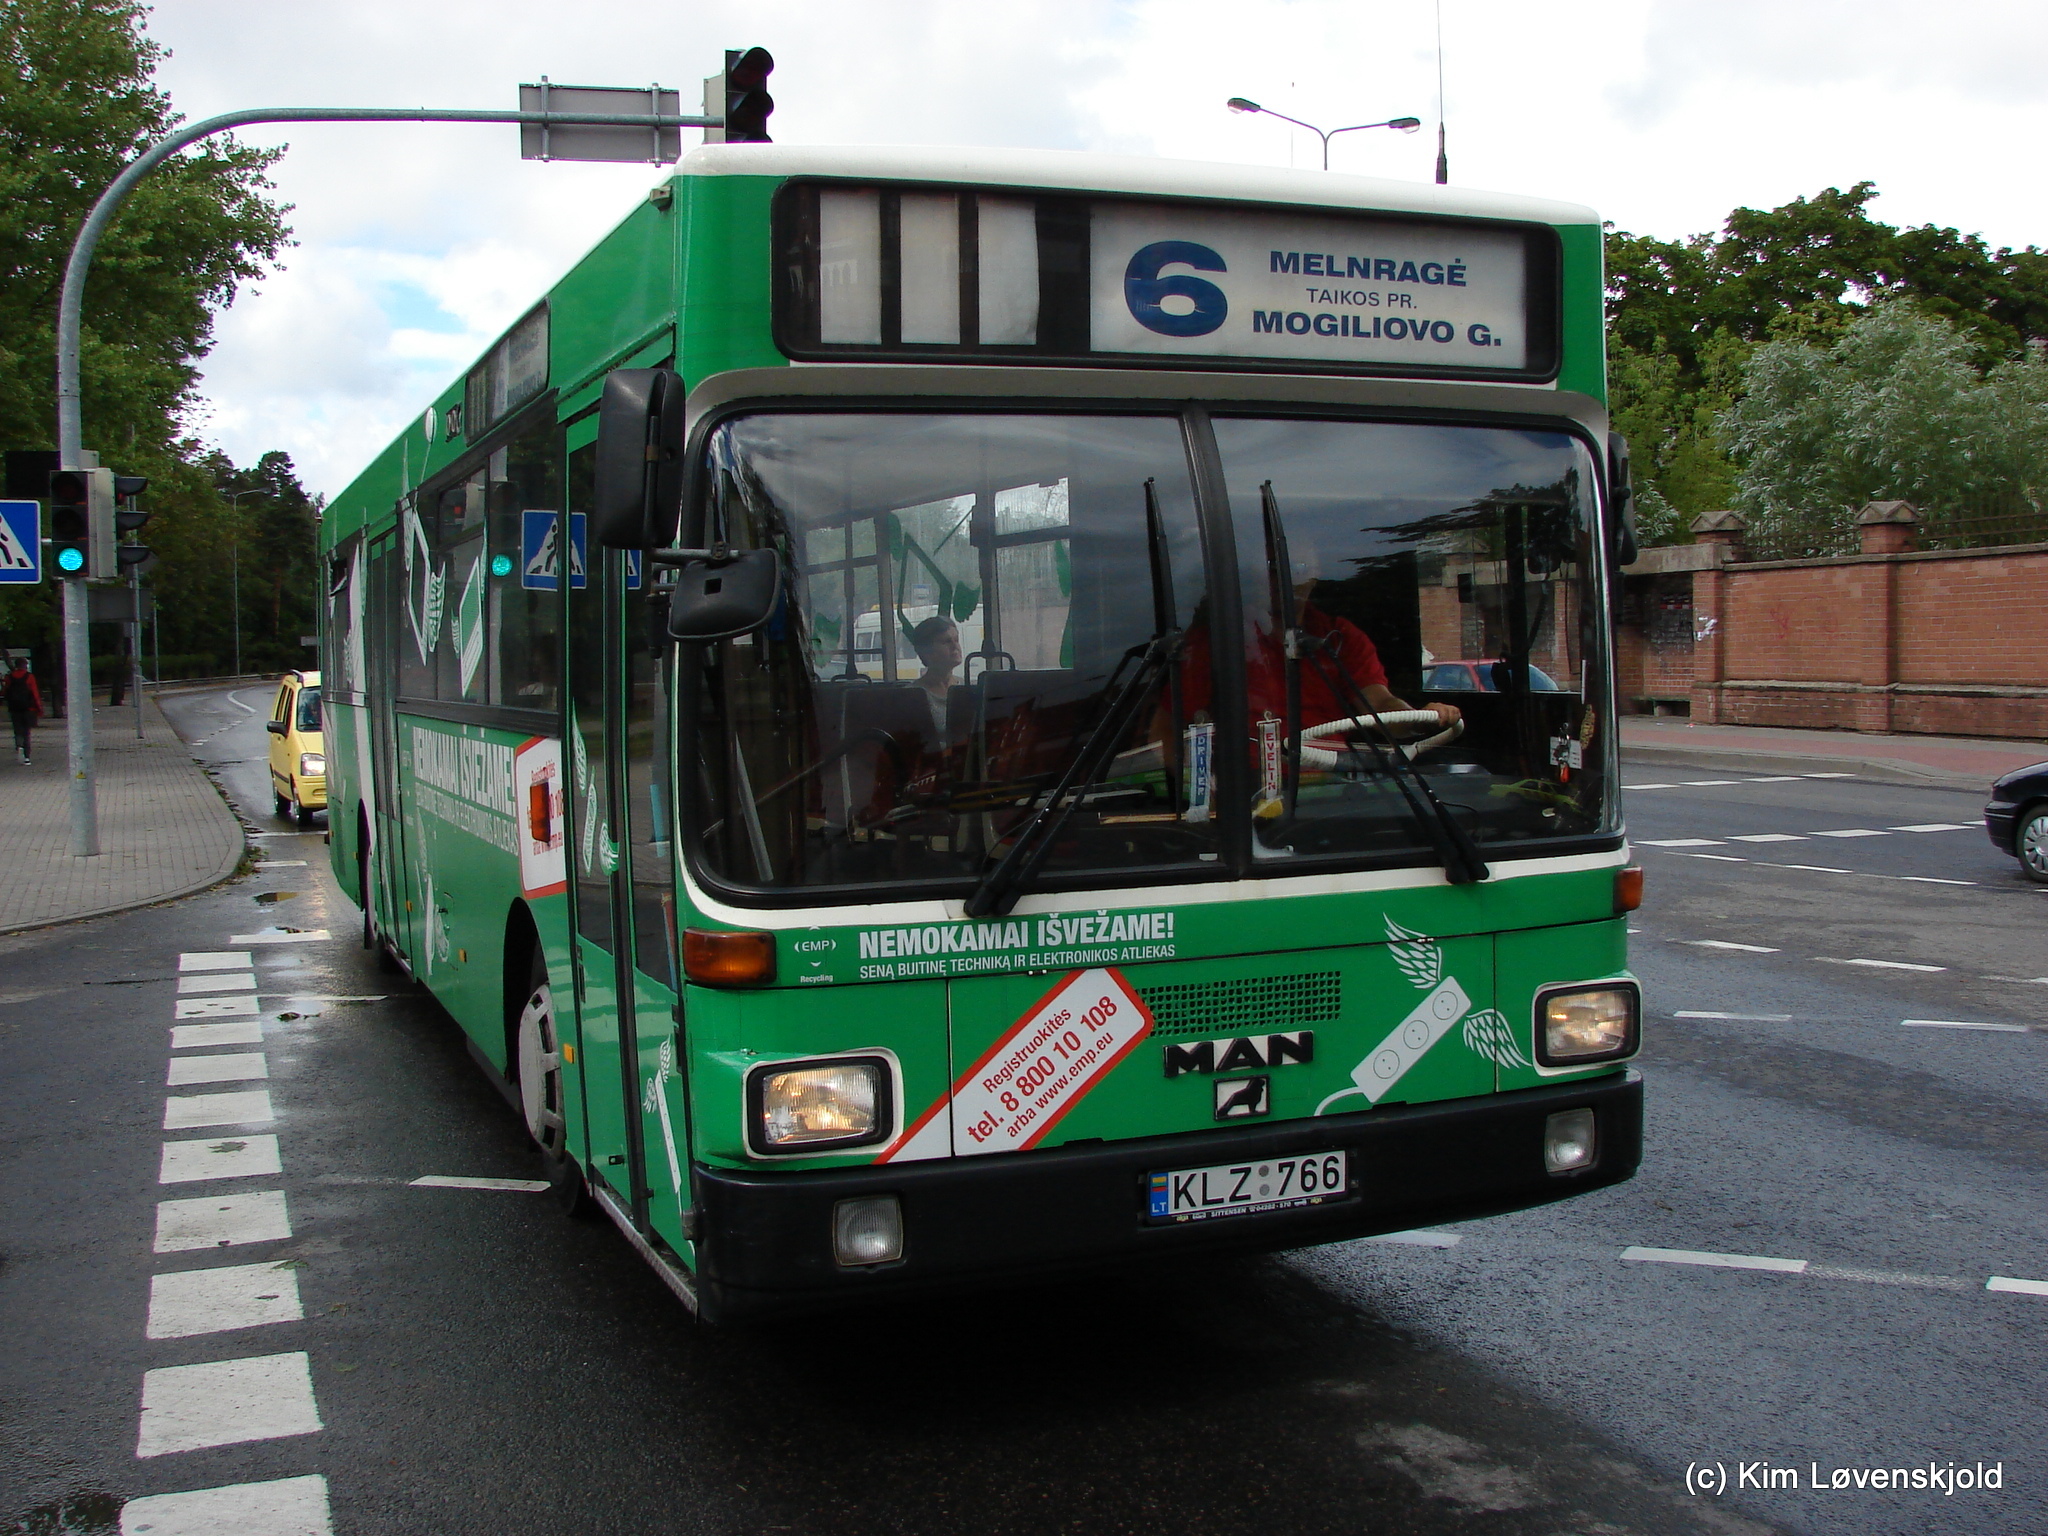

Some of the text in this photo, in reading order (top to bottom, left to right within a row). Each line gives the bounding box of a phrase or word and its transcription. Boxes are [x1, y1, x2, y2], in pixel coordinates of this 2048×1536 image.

[1124, 240, 1228, 337] 6
[1270, 251, 1467, 287] MELNRAGĖ
[1306, 288, 1418, 309] TAIKOS PR.
[1252, 311, 1502, 346] MOGILIOVO G.
[1197, 735, 1206, 796] DRIVER
[1265, 732, 1276, 791] EVELIN
[859, 909, 1175, 959] NEMOKAMAI IŠVEŽAME!
[800, 973, 834, 984] Recycling
[860, 944, 1176, 980] SENĄ BUITINĘ TECHNIKĄ IR ELEKTRONIKOS ATLIEKAS
[967, 995, 1118, 1143] tel. 8 800 10 108
[982, 1008, 1072, 1093] Registruokitės
[1163, 1030, 1314, 1078] MAN
[1006, 1032, 1114, 1138] arba www.emp.eu
[1151, 1202, 1167, 1213] LT
[1173, 1155, 1341, 1210] KLZ 766
